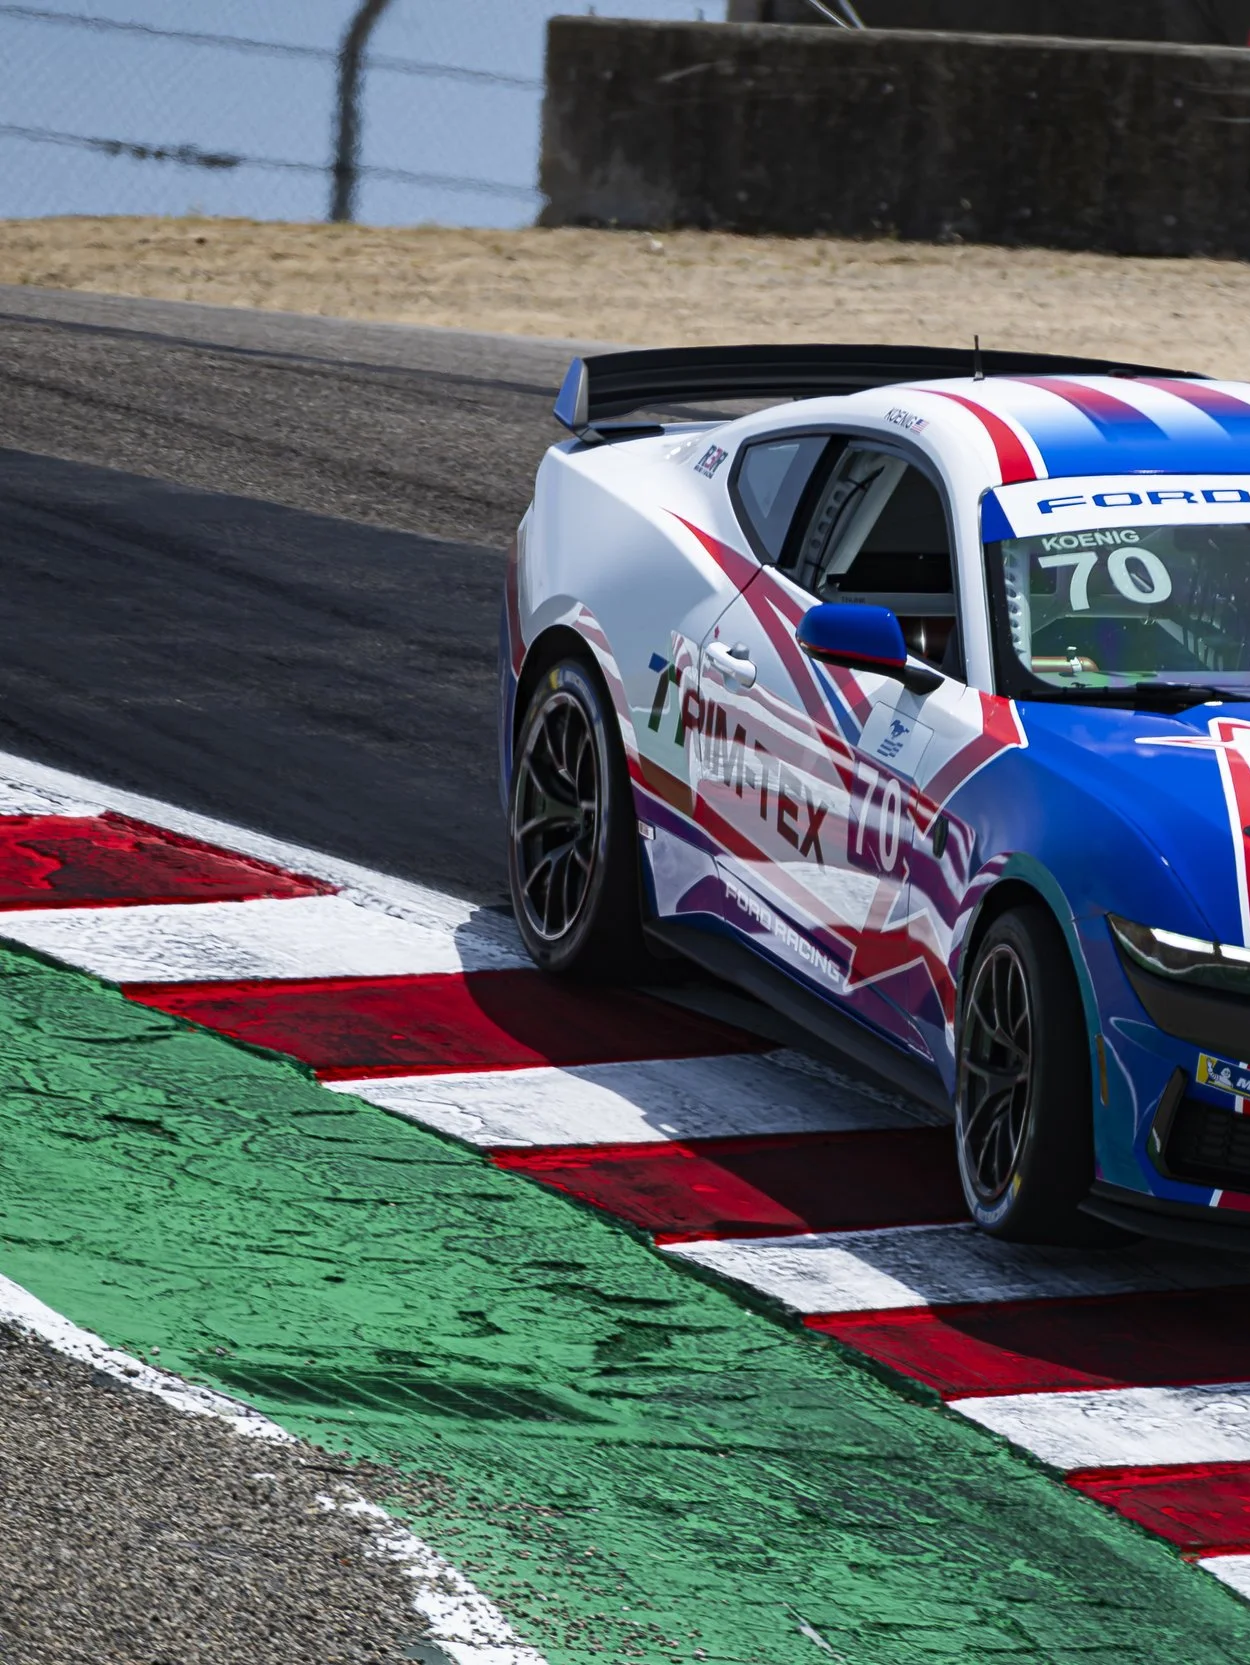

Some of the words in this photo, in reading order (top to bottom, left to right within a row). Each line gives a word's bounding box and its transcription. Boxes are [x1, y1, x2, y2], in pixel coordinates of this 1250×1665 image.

[1037, 547, 1172, 611] 70
[1042, 529, 1140, 551] KOENIG
[648, 652, 827, 875] TRIM-TEX
[856, 761, 901, 872] 70
[725, 881, 772, 931] FORD
[774, 918, 840, 983] RACING
